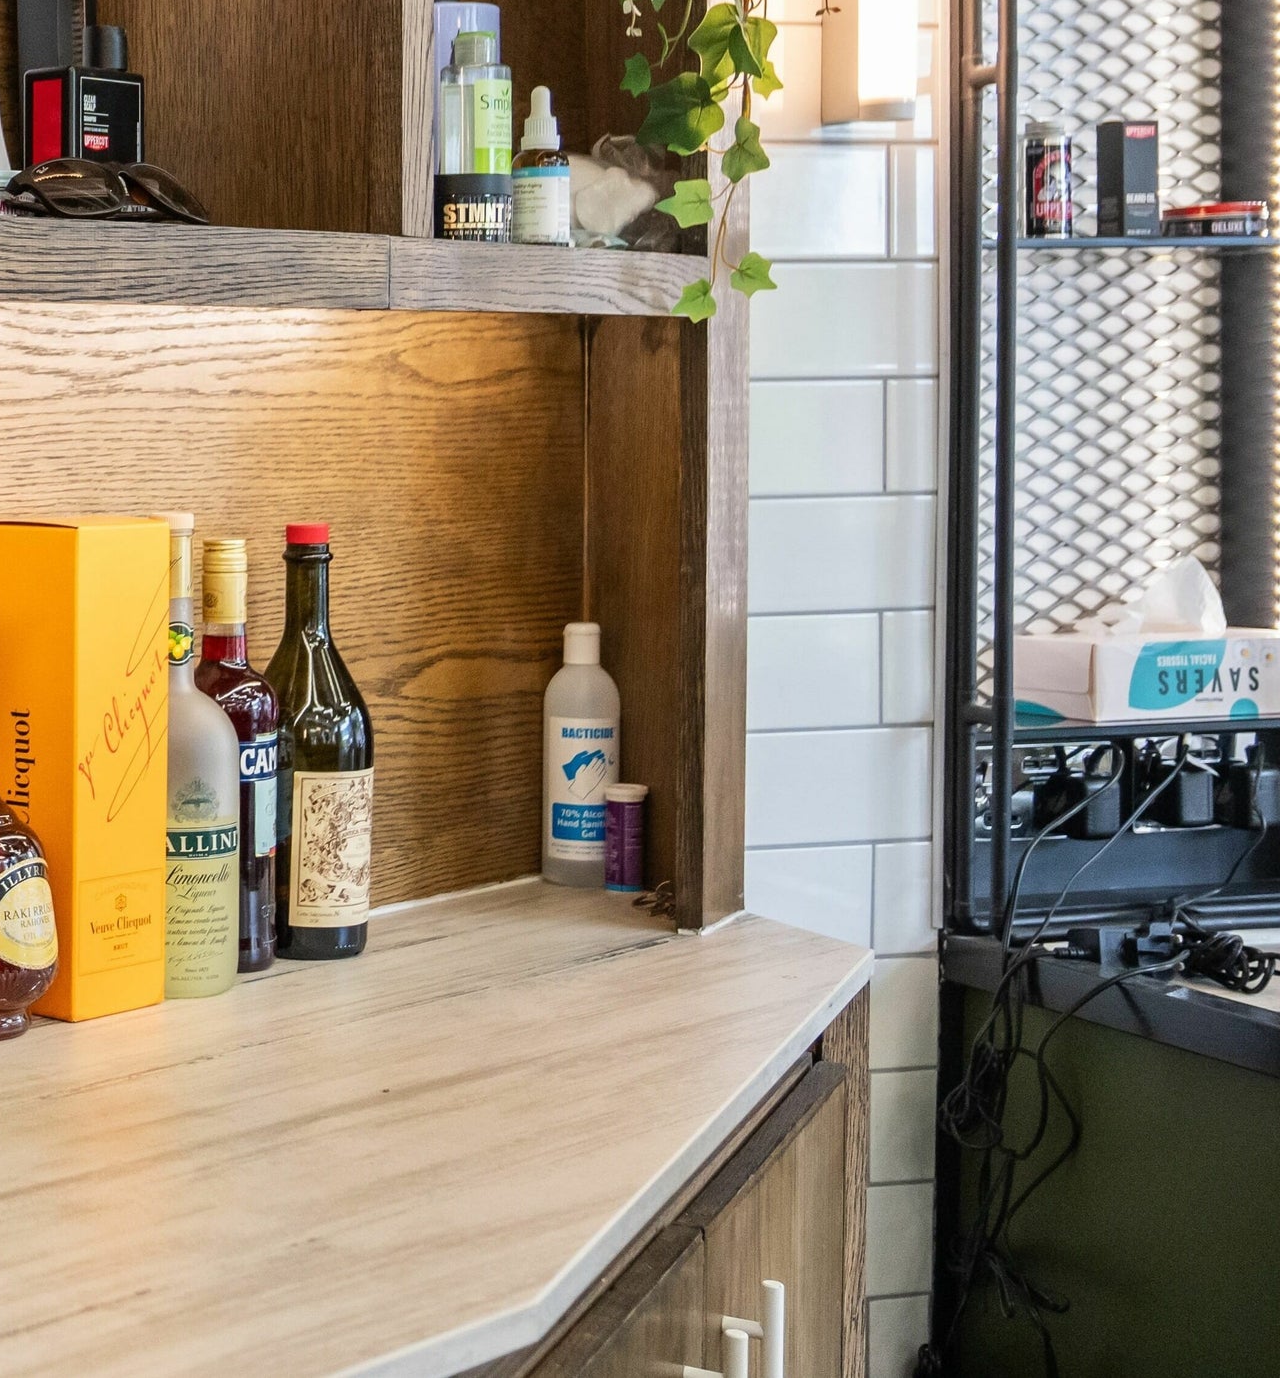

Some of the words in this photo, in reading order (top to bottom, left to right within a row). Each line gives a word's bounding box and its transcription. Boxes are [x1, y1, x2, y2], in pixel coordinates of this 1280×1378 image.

[84, 136, 109, 149] UPPERCUT
[443, 202, 504, 223] STMNT
[1211, 221, 1244, 234] DELUXE
[1156, 655, 1188, 668] TISSUES
[1189, 653, 1217, 666] FACIAL
[1158, 666, 1259, 696] SAVERS
[561, 727, 614, 739] BACTICIDE
[5, 707, 36, 825] licquot
[561, 808, 581, 818] 70%
[557, 818, 580, 827] Hand
[581, 830, 596, 838] Gel
[165, 863, 230, 894] Limoncello
[176, 886, 217, 903] Liqueur
[4, 908, 31, 921] RAKI
[90, 921, 115, 935] Veuve
[116, 913, 152, 930] Clicquot
